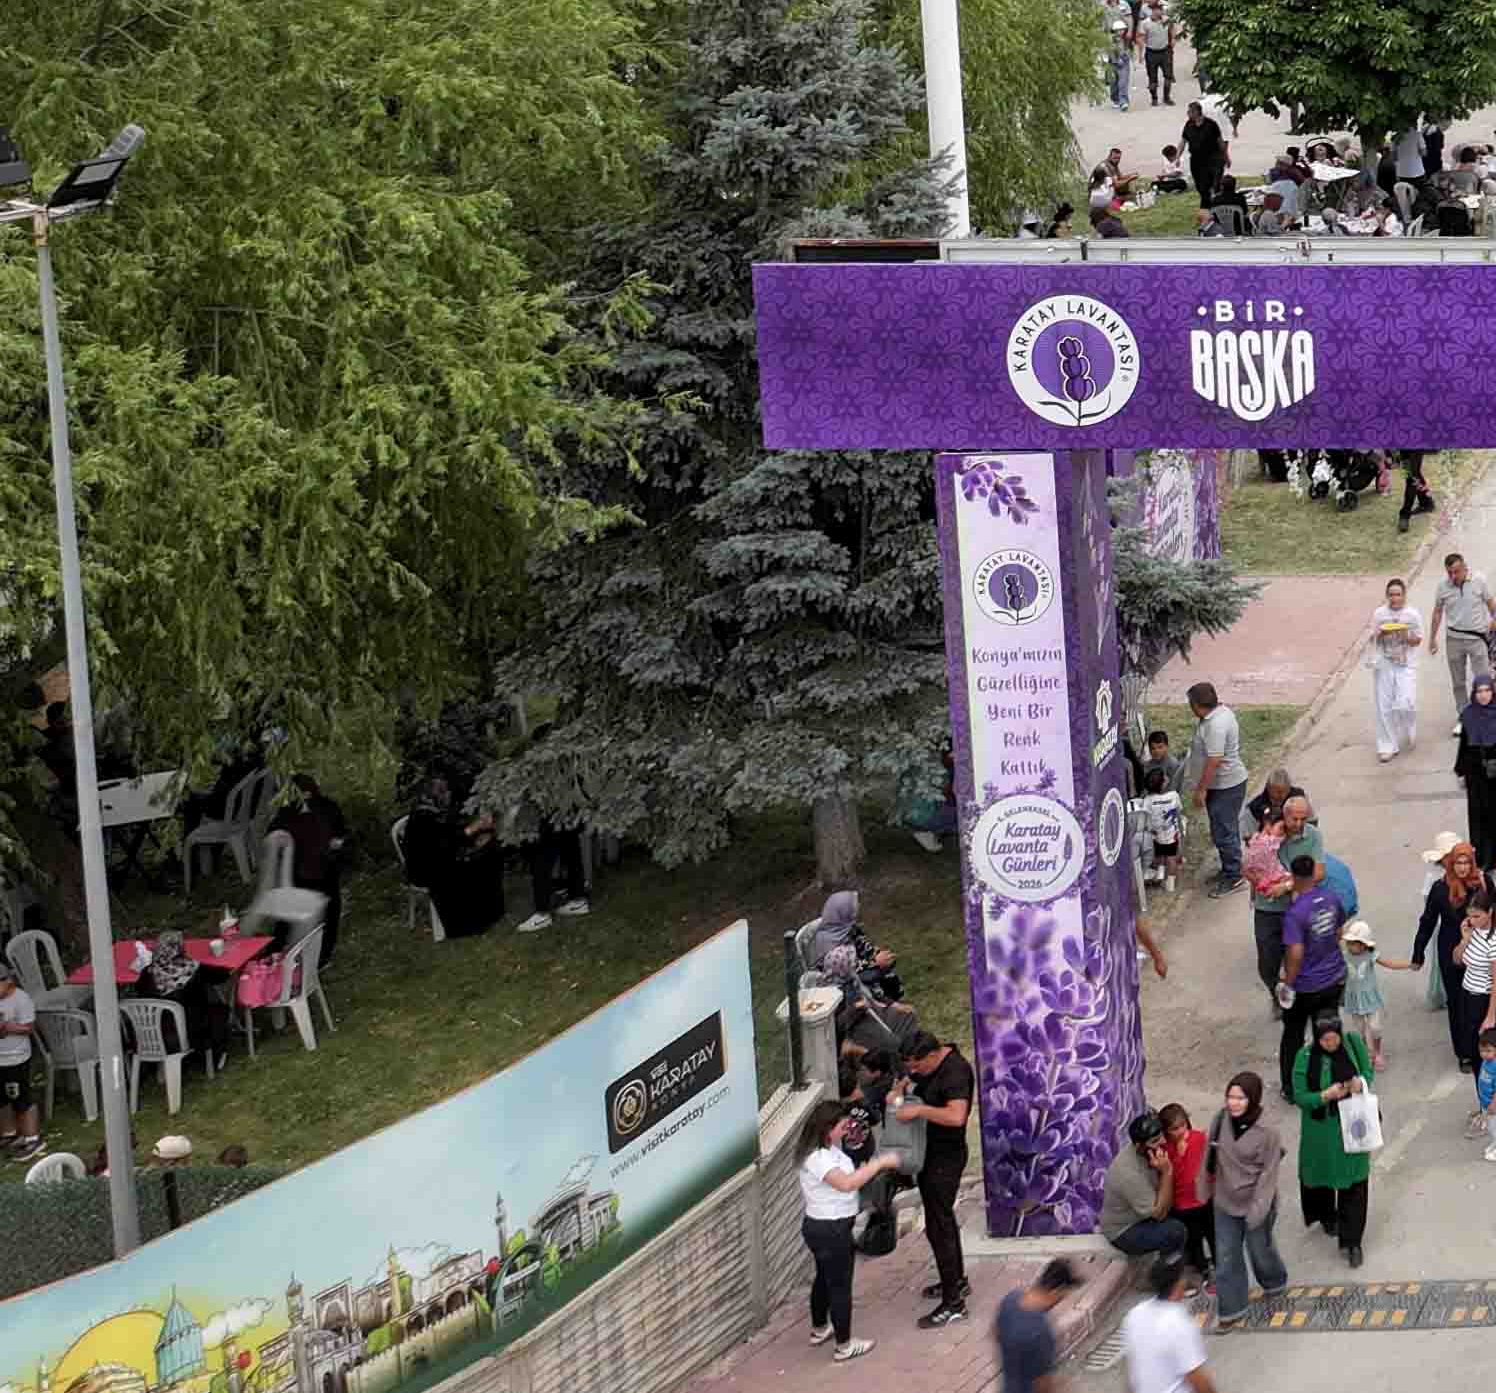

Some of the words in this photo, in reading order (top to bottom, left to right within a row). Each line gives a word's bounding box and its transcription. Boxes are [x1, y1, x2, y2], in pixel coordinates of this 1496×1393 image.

[1013, 303, 1057, 372] KARATAY
[1067, 300, 1134, 372] LAVANTASI
[987, 703, 1022, 721] Yeni
[1028, 703, 1054, 720] Bir
[1003, 730, 1041, 748] Renk
[1004, 822, 1062, 841] Karatay
[991, 838, 1049, 856] Lavanta
[1002, 854, 1058, 874] Günleri
[609, 1086, 730, 1179] www.visitkaratay.com
